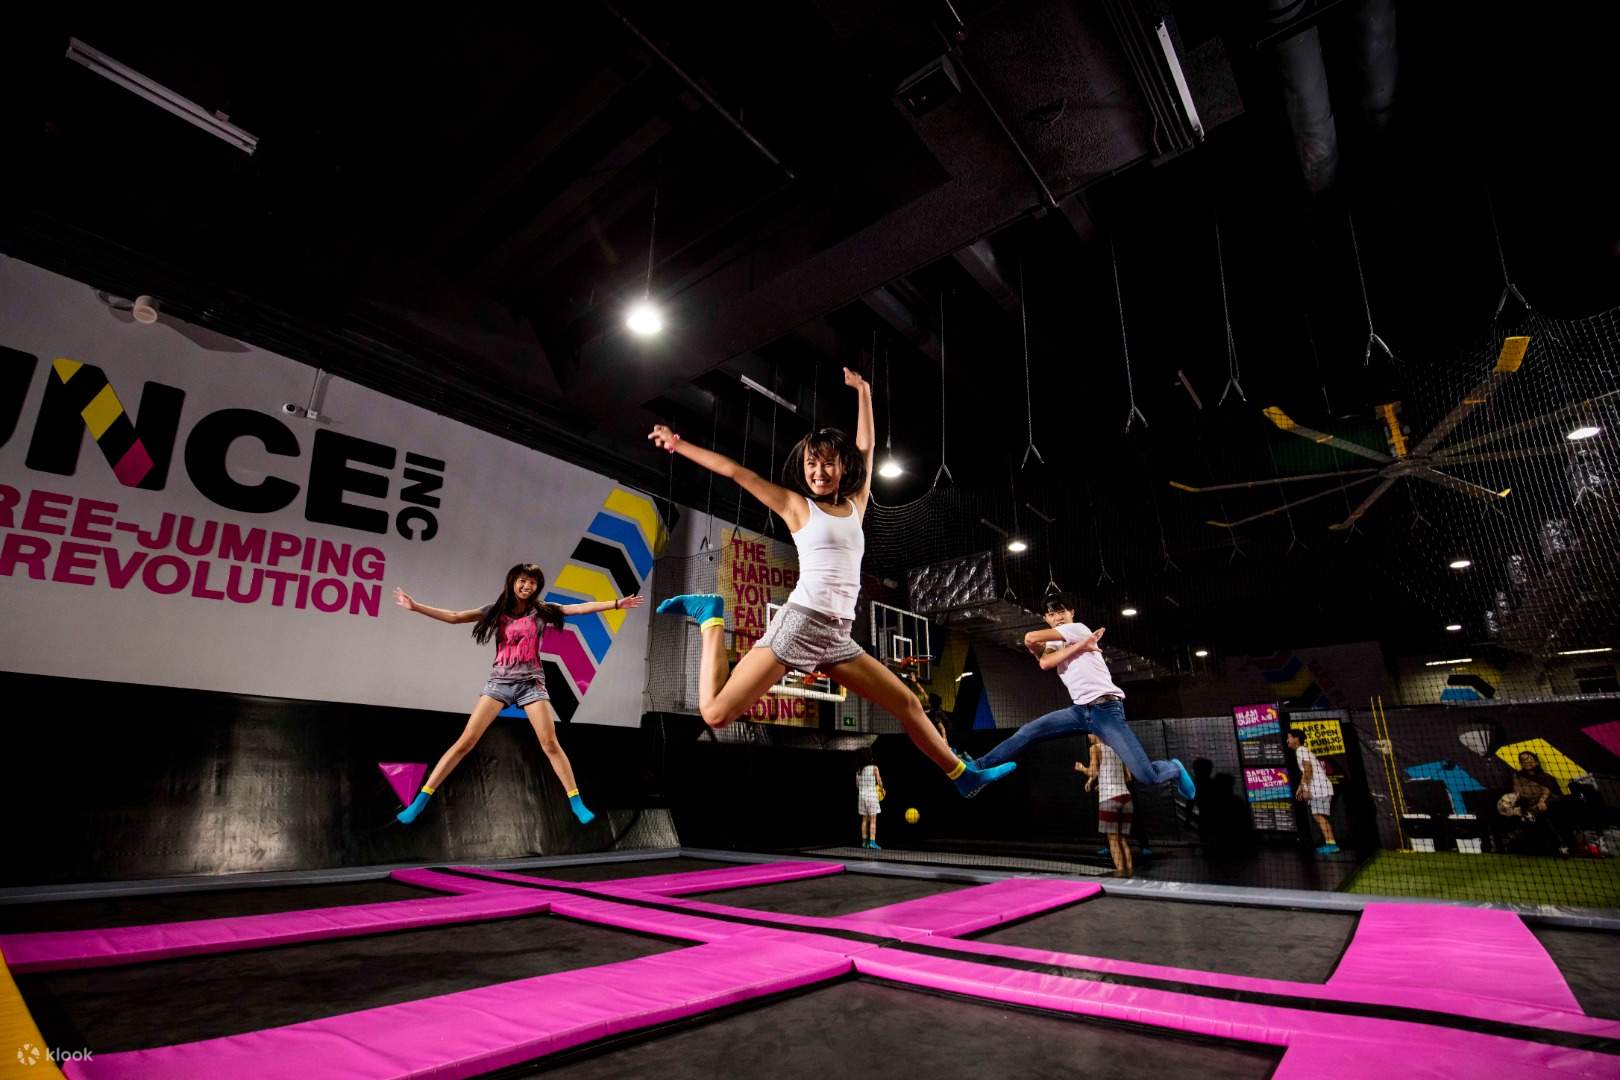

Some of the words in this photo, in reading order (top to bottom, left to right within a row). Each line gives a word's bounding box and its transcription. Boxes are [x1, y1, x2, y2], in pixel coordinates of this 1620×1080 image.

[396, 451, 446, 542] INC
[731, 538, 767, 564] THE
[0, 533, 382, 617] REVOLUTION
[733, 582, 772, 607] YOU
[735, 605, 770, 629] FAL
[746, 697, 817, 721] OUNCE
[1302, 723, 1326, 733] AREA
[1314, 729, 1338, 738] OPEN
